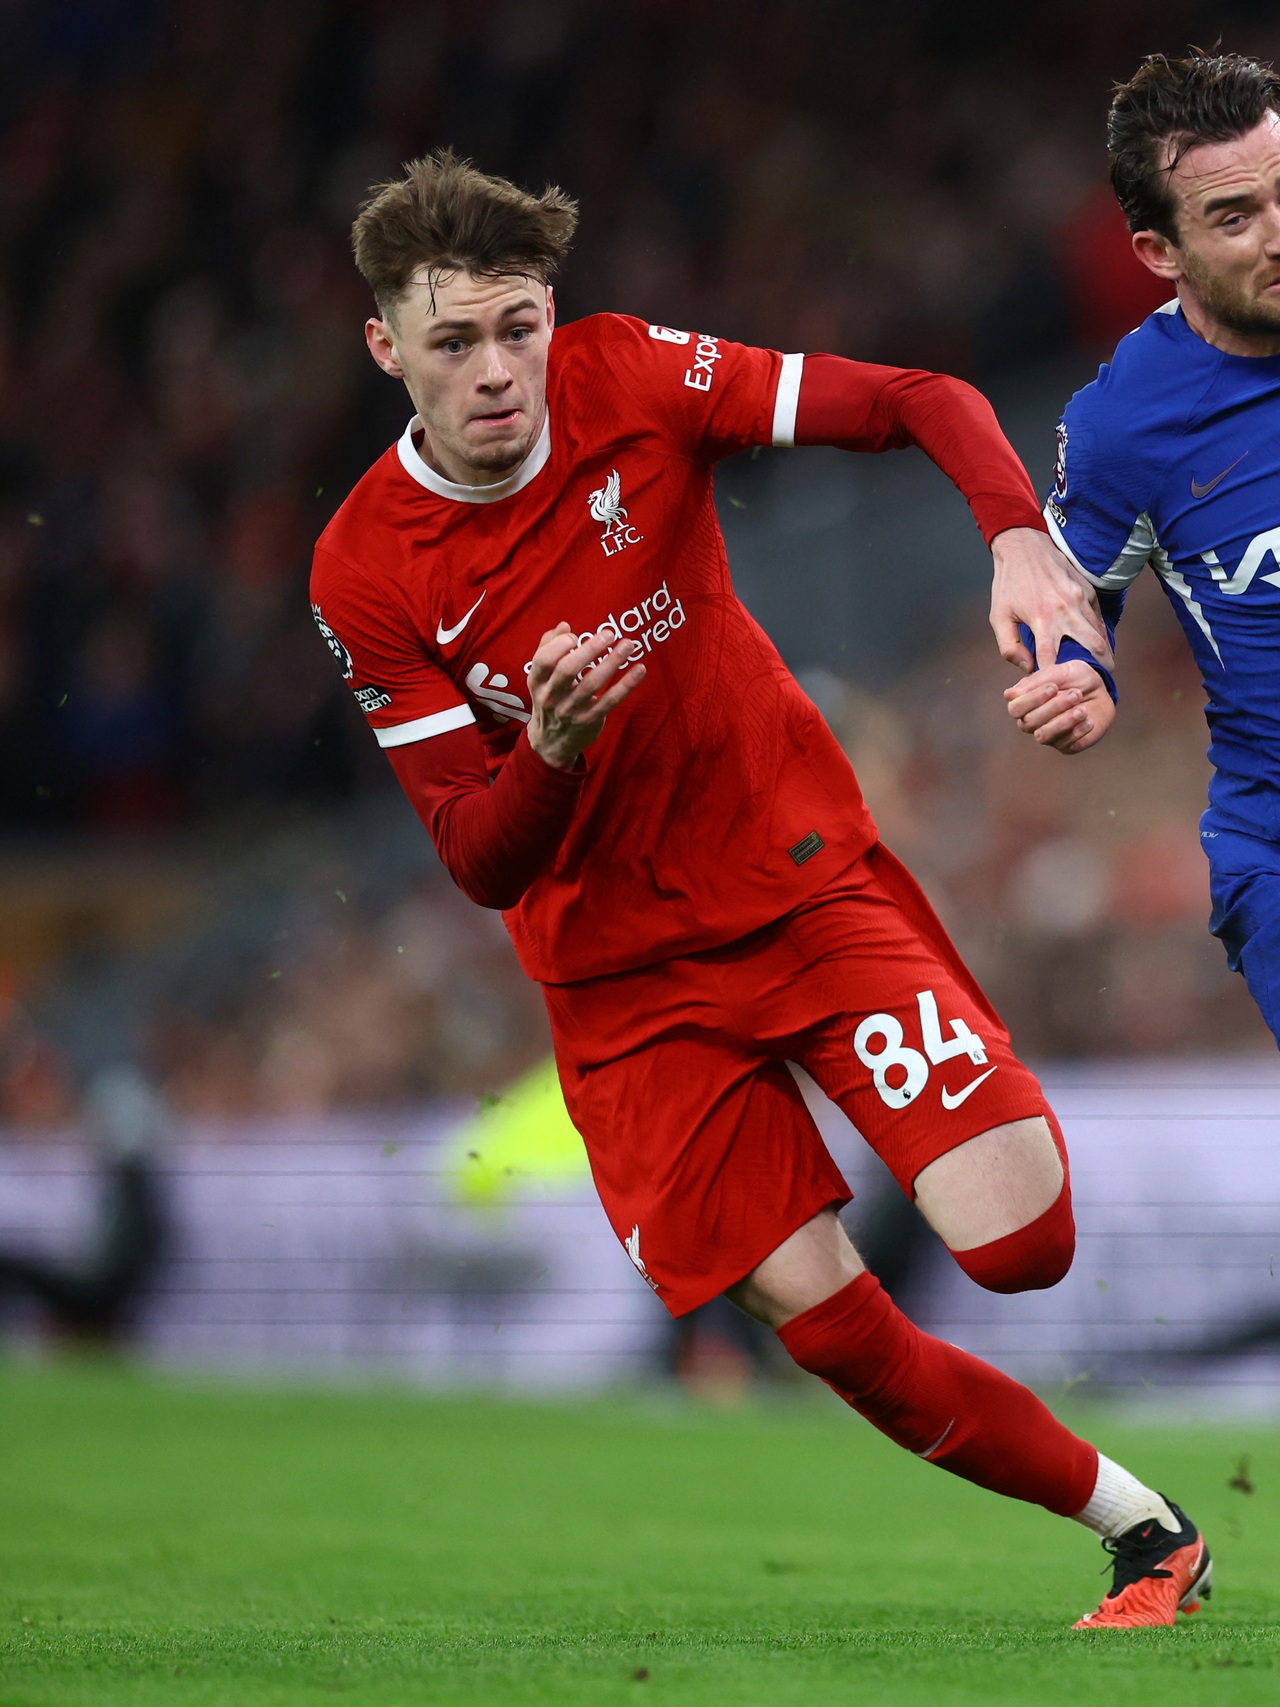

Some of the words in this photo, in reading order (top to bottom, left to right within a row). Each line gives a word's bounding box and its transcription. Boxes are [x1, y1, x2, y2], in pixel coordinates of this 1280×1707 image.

[684, 334, 722, 392] Expe
[600, 526, 644, 557] L.F.C.
[523, 580, 672, 676] ndard
[573, 599, 687, 685] aered
[354, 687, 379, 702] oom
[853, 990, 988, 1110] 84
